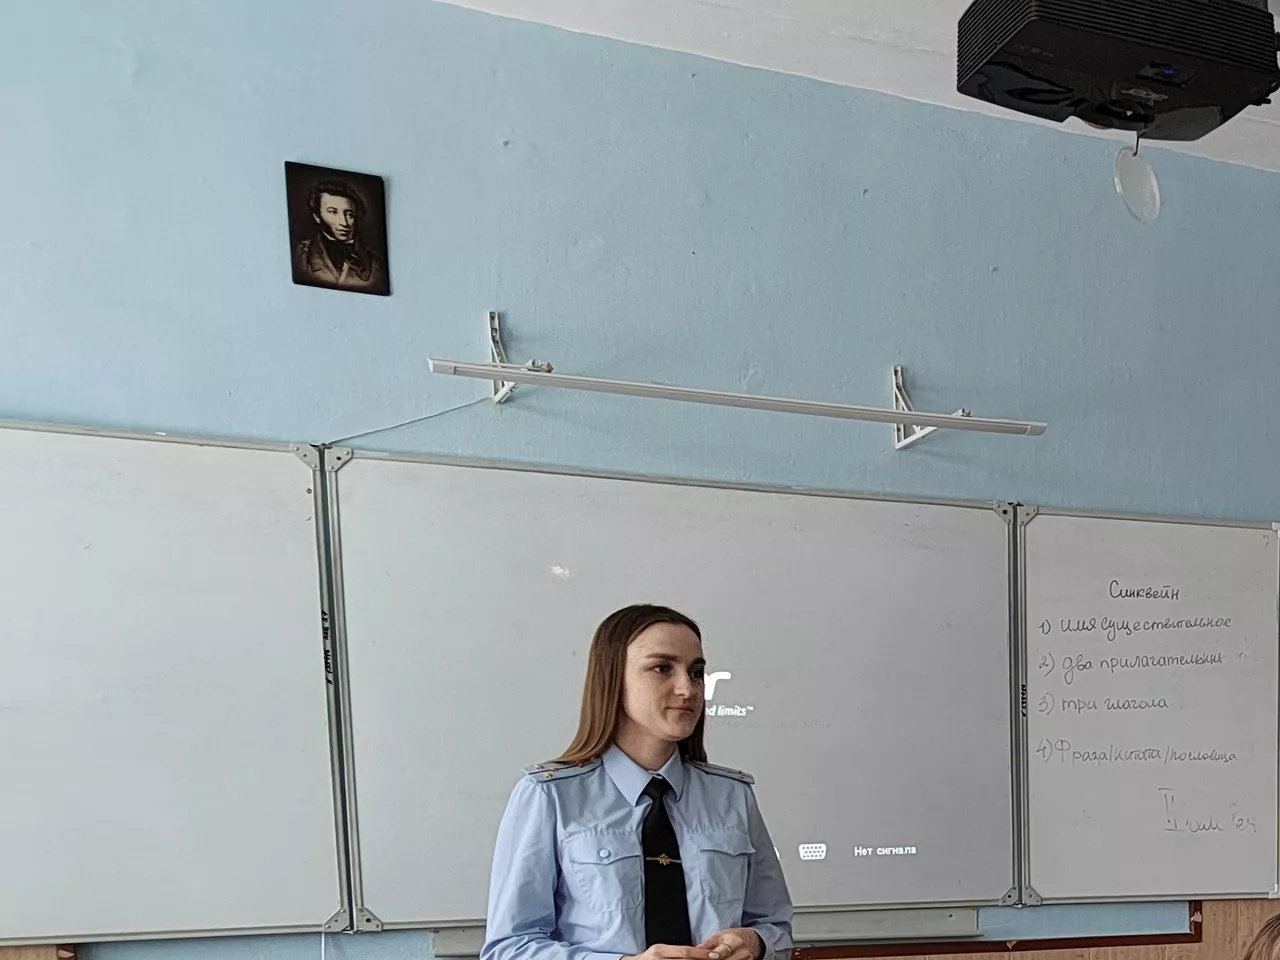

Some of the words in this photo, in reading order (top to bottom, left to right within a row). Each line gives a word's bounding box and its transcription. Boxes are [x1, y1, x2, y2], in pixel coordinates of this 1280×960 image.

[1109, 579, 1180, 600] Синквейн
[1038, 619, 1052, 635] 1)
[1038, 652, 1055, 678] 2)
[1062, 653, 1093, 685] два
[1037, 692, 1055, 716] 3)
[1061, 698, 1098, 715] три
[1104, 697, 1169, 711] глагола
[854, 846, 873, 857] Нет
[876, 846, 917, 856] сигнала
